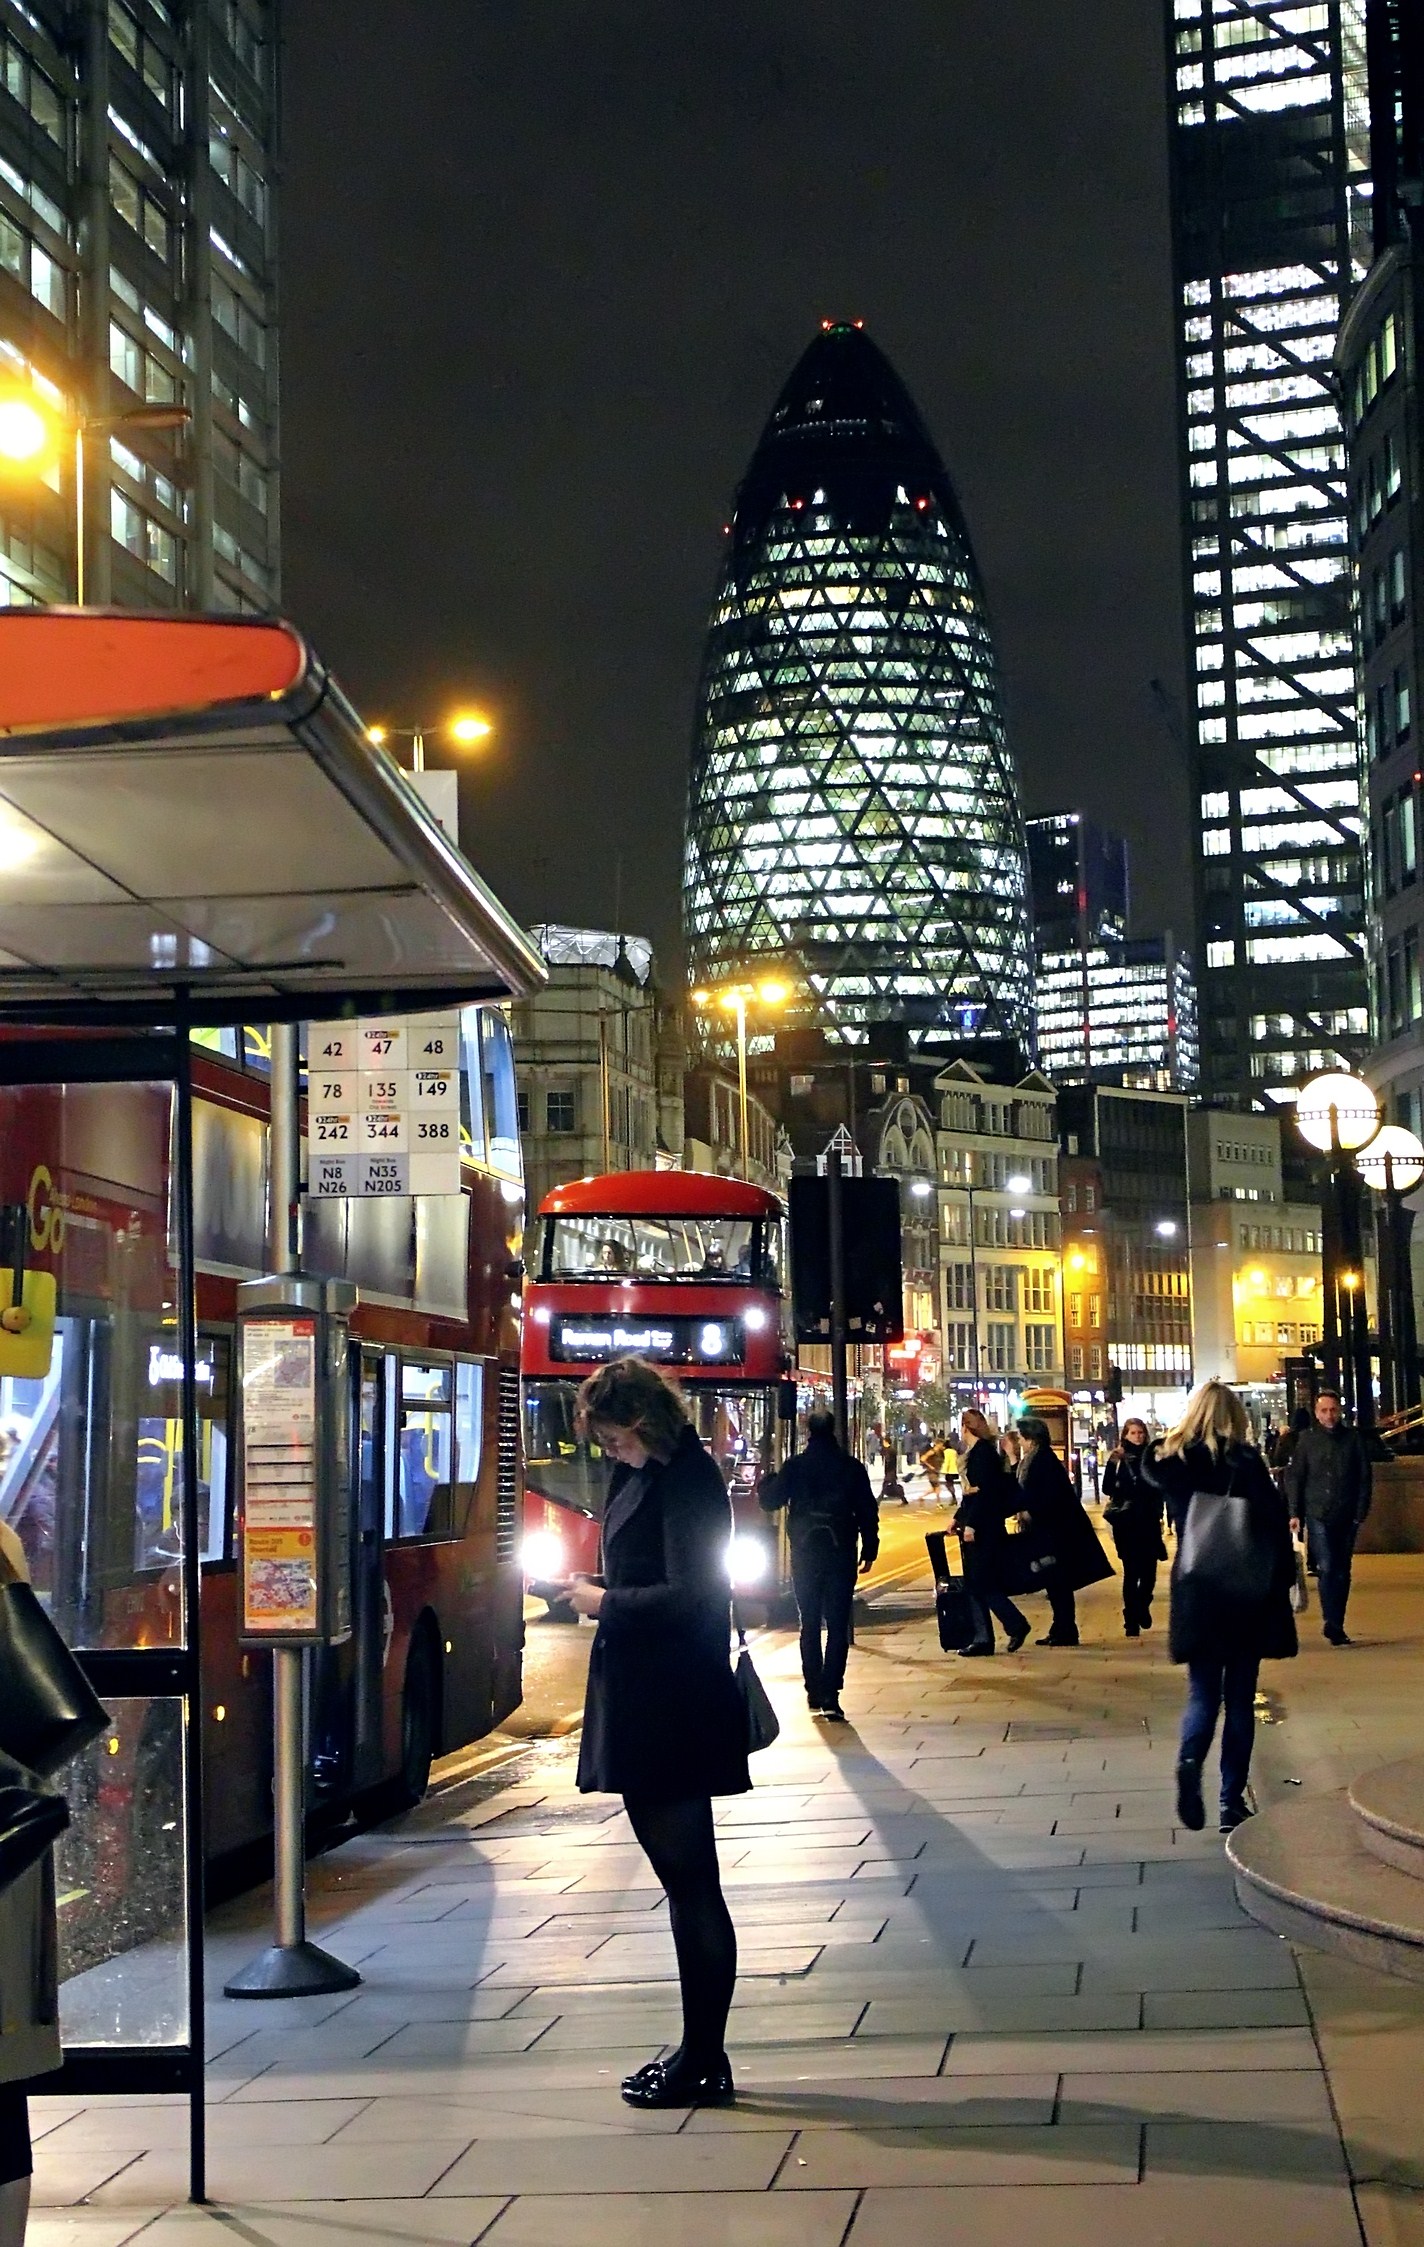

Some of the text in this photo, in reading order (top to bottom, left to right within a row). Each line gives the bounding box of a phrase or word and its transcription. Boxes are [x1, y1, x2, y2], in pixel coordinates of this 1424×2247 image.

[323, 1043, 342, 1056] 42
[372, 1041, 392, 1054] 47
[423, 1041, 443, 1054] 48
[323, 1085, 342, 1098] 78
[368, 1083, 396, 1097] 135
[418, 1082, 447, 1095] 149
[318, 1126, 348, 1140] 242
[368, 1125, 398, 1138] 344
[418, 1124, 449, 1138] 388
[323, 1168, 342, 1179] N8
[369, 1166, 397, 1177] N35
[319, 1182, 347, 1193] N26
[365, 1181, 401, 1192] N205
[27, 1165, 65, 1254] Go
[701, 1323, 723, 1355] 8
